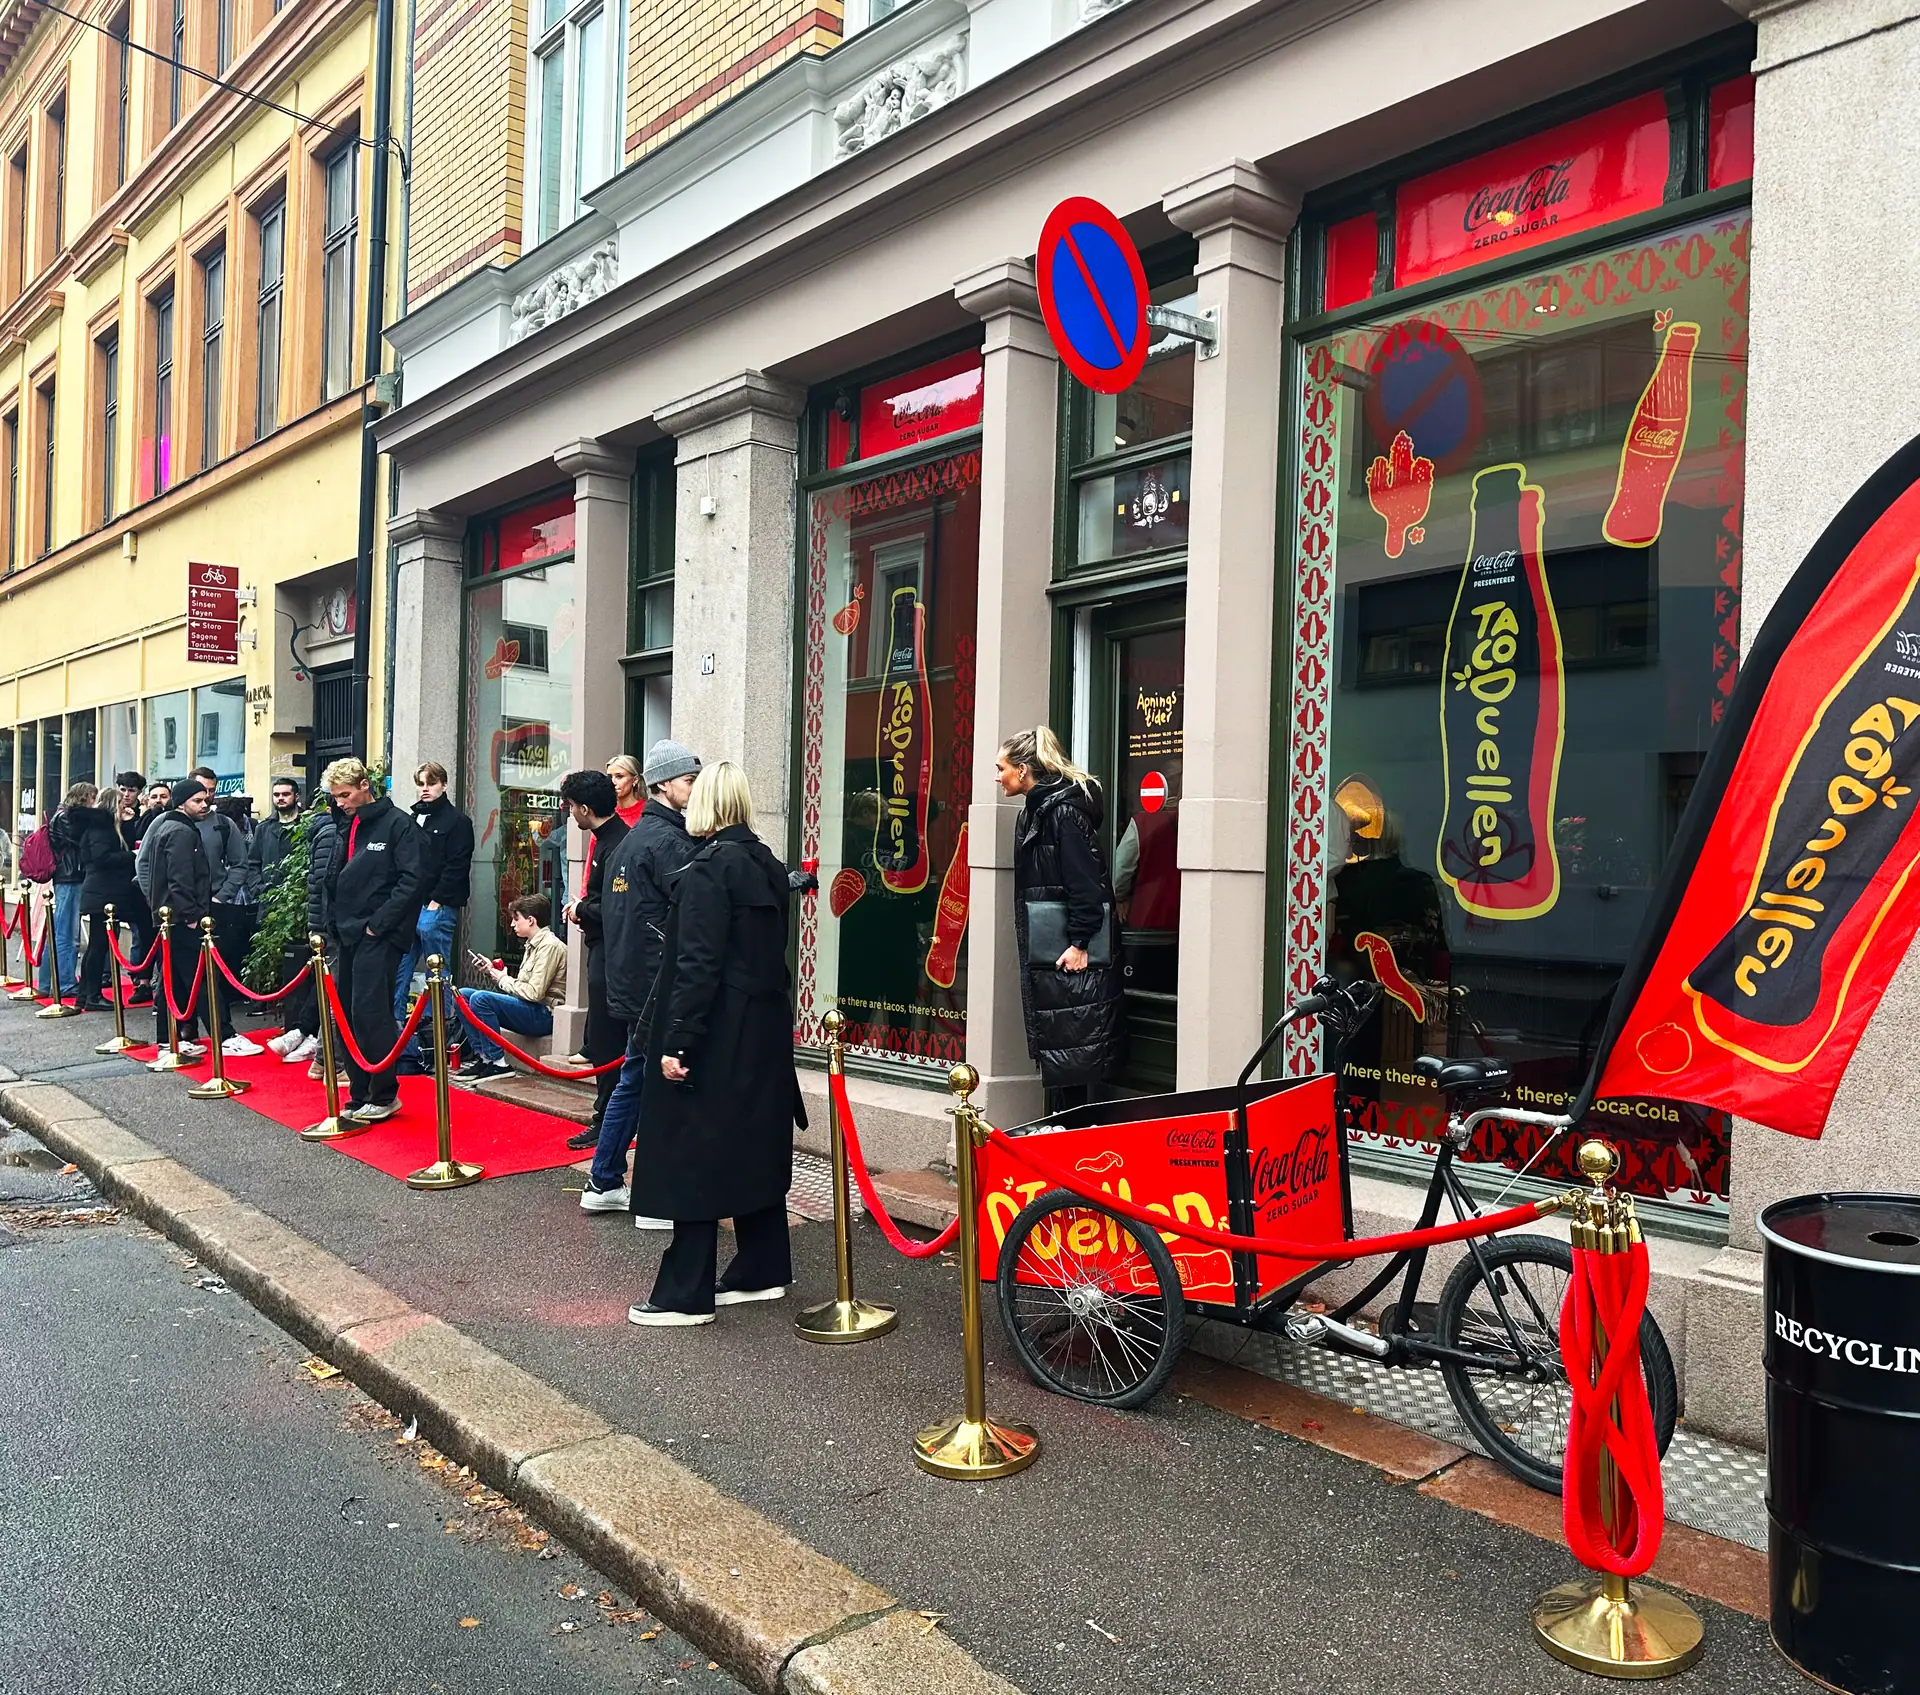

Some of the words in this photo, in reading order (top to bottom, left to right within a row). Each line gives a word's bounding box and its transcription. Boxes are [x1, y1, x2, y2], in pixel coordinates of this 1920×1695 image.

[1464, 158, 1576, 232] Coca-Cola
[1474, 231, 1508, 250] ZERO
[1513, 214, 1558, 236] SUGAR
[899, 430, 916, 441] ZERO
[917, 423, 939, 435] SUGAR
[1635, 426, 1680, 447] Coca-Cola
[1473, 550, 1518, 572] Coca-Cola
[1473, 575, 1516, 588] PRESENTERER
[200, 590, 222, 599] Økern
[191, 600, 216, 609] Sinsen
[191, 609, 213, 618] Tøyen
[202, 622, 222, 630] Storo
[191, 632, 218, 641] Sagene
[191, 641, 220, 650] Torshov
[194, 653, 225, 661] Sentrum
[1136, 686, 1177, 716] Åpnings
[1144, 708, 1173, 728] tider
[822, 993, 847, 1006] Where
[847, 996, 867, 1008] there
[868, 1000, 882, 1010] are
[883, 1001, 907, 1014] tacos,
[908, 1004, 937, 1017] there's
[1385, 1068, 1426, 1087] there
[1166, 1128, 1218, 1149] Coca-Cola
[1251, 1121, 1332, 1212] Coca-Cola
[1266, 1204, 1289, 1223] ZERO
[1291, 1190, 1319, 1210] SUGAR
